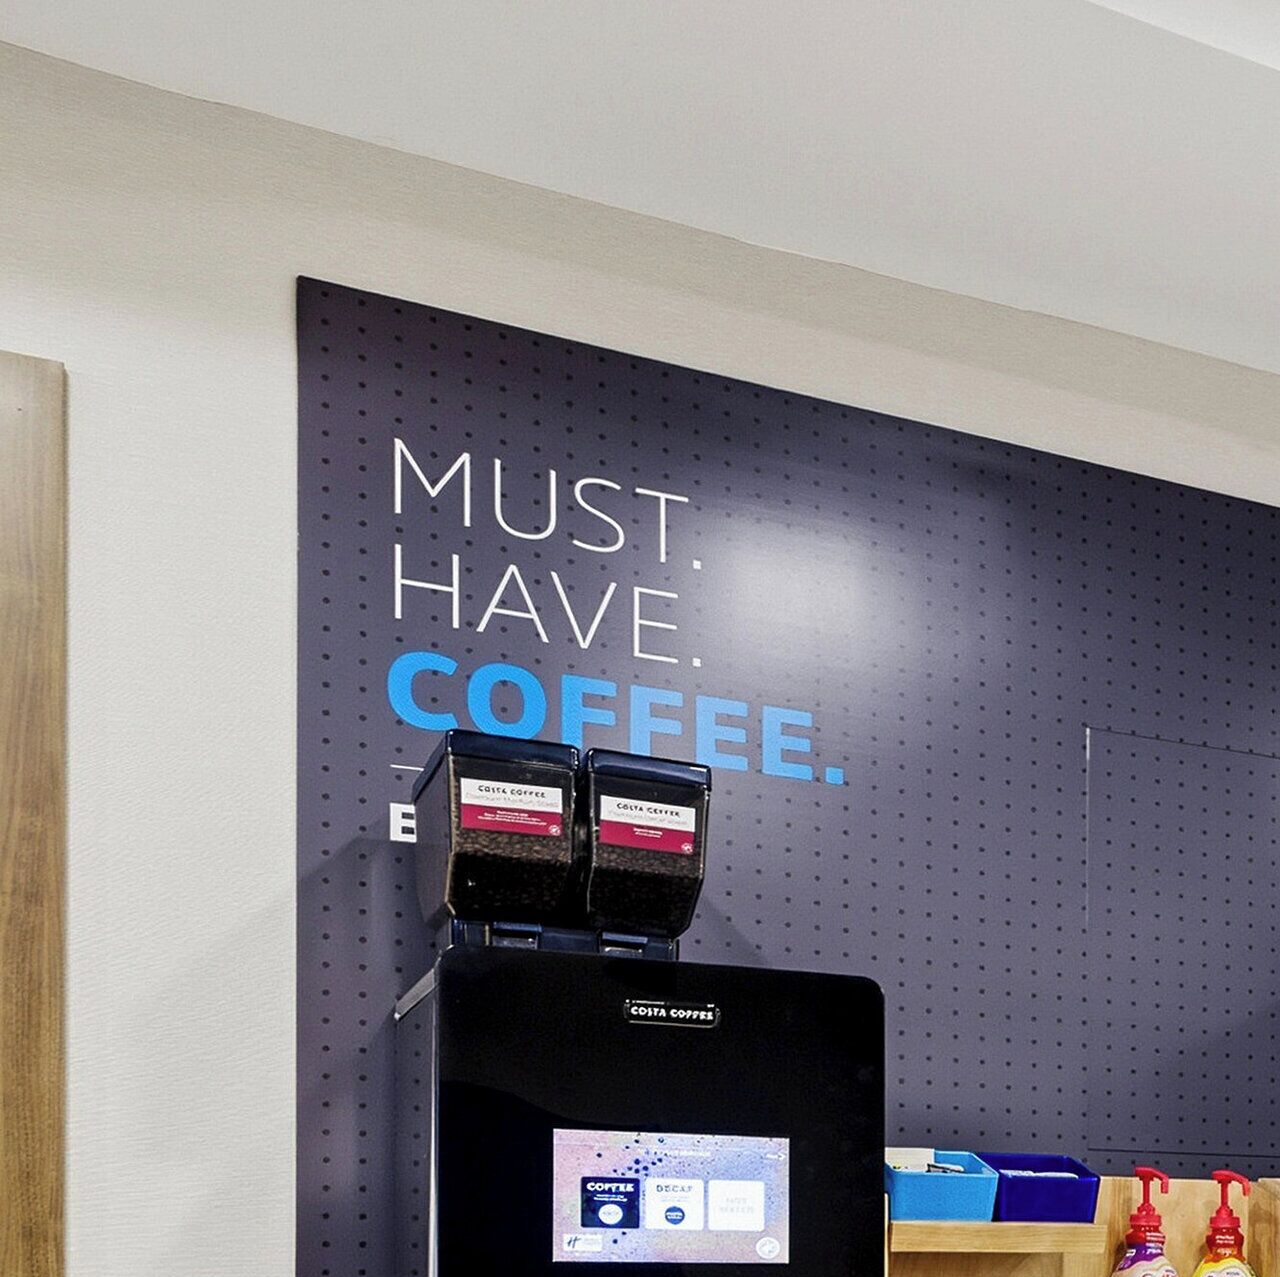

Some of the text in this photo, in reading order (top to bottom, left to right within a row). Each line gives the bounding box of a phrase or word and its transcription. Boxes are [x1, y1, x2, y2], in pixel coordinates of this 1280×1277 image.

[394, 437, 702, 570] MUST.
[394, 543, 702, 668] HAVE.
[386, 650, 844, 785] COFFEE.
[630, 1006, 714, 1020] COSTA COFFEE
[586, 1182, 635, 1192] COFFEE
